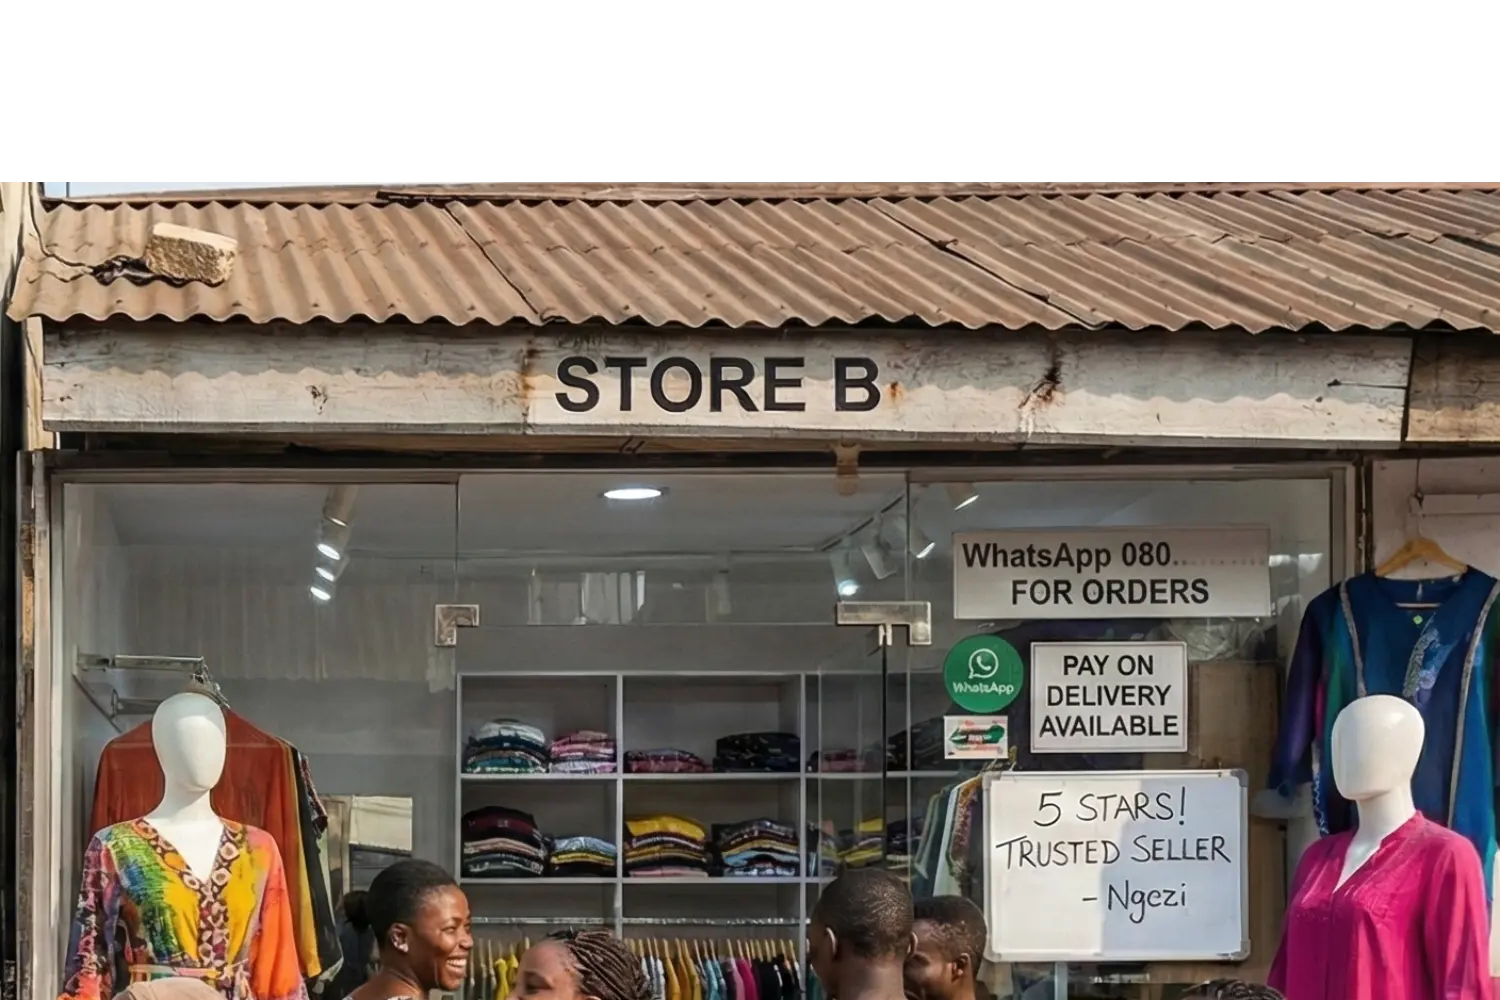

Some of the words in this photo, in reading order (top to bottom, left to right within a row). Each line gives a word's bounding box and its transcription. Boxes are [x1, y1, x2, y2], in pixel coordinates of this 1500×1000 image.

[555, 355, 806, 413] STORE
[834, 357, 881, 412] B
[962, 542, 1111, 573] WhatsApp
[1011, 579, 1073, 605] FOR
[1082, 578, 1210, 605] ORDERS
[1063, 655, 1109, 676] PAY
[1117, 655, 1154, 676] ON
[952, 681, 1015, 696] WhatsApp
[1046, 684, 1172, 707] DELIVERY
[1039, 715, 1179, 738] AVAILABLE
[1033, 791, 1063, 827] 5
[1076, 786, 1186, 826] STARS!
[995, 835, 1121, 870] TRUSTED
[1130, 834, 1232, 864] SELLER
